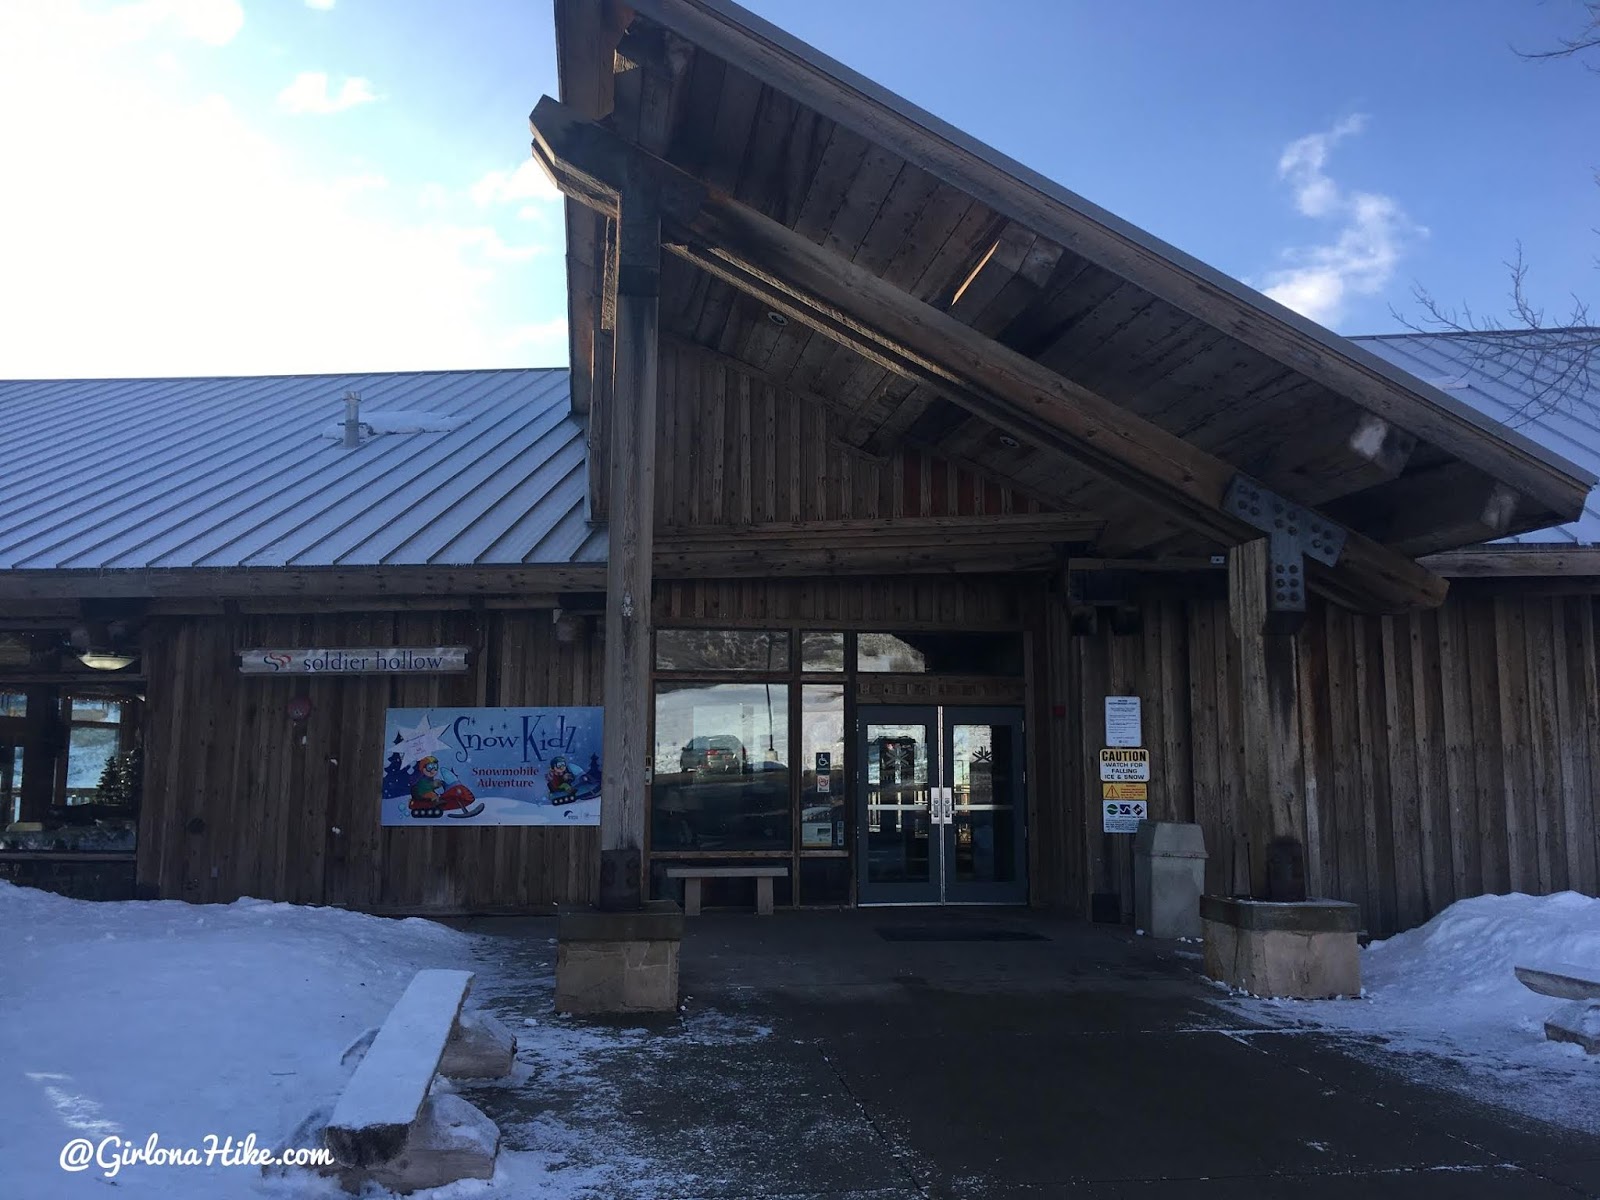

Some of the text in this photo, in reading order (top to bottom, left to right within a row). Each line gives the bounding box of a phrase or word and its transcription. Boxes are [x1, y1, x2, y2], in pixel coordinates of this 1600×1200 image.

[303, 650, 443, 671] soldier hollow
[1102, 750, 1147, 762] CAUTION
[472, 766, 540, 777] Snowmobile
[477, 777, 535, 788] Adventure
